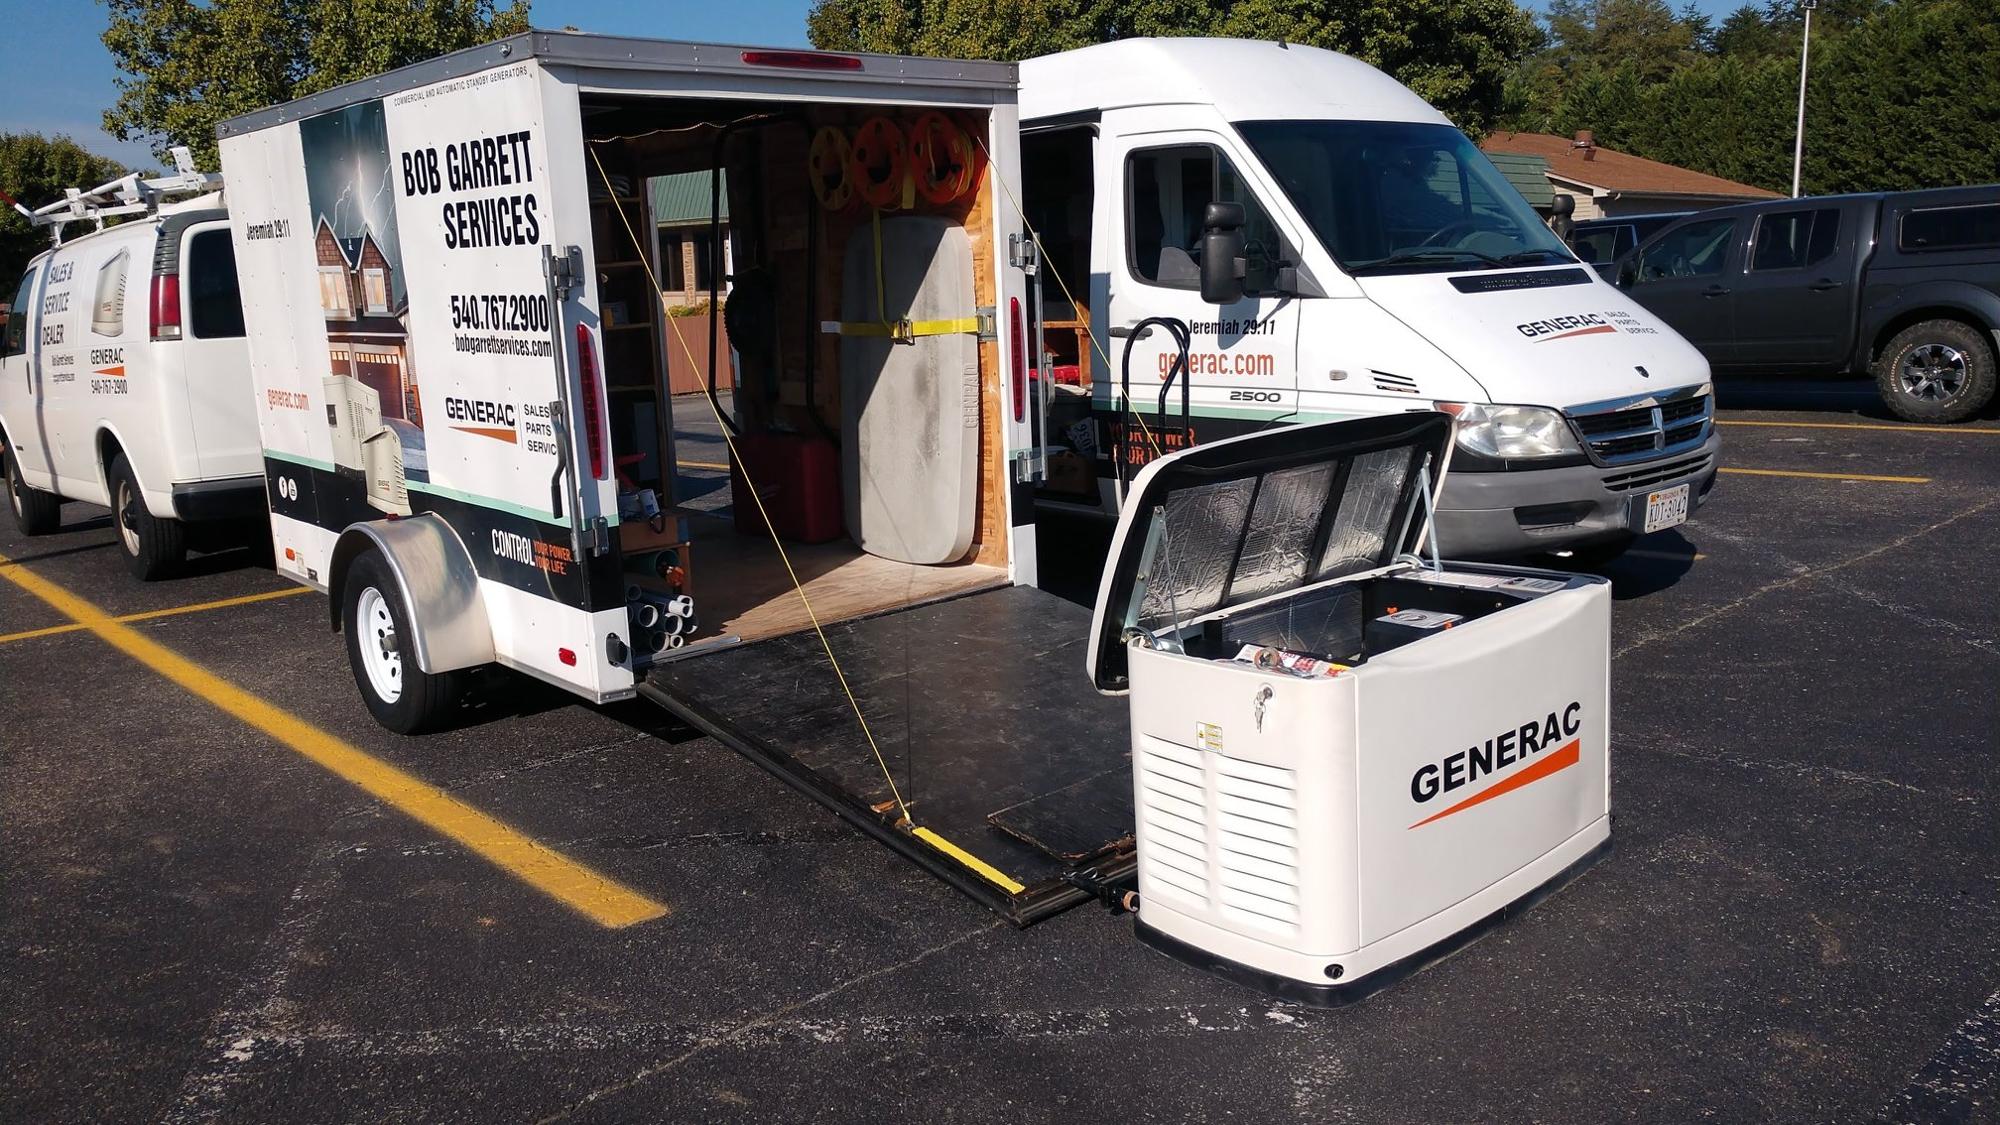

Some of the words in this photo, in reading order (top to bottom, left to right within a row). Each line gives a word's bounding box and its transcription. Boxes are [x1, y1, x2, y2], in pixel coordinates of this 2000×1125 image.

[394, 94, 425, 106] COMMERCIAL
[426, 88, 436, 98] AND
[436, 82, 465, 95] AUTOMATIC
[466, 75, 489, 89] STANDBY
[489, 65, 528, 83] GENERATORS
[402, 148, 441, 197] BOB
[445, 130, 533, 192] GARRETT
[246, 220, 274, 240] Jeremiah
[274, 219, 291, 238] 29:11
[443, 193, 540, 250] SERVICES
[48, 262, 67, 285] SALES
[67, 261, 74, 280] &
[43, 292, 70, 315] SERVICE
[450, 294, 550, 332] 540.767.2900
[42, 324, 64, 346] DEALER
[1189, 319, 1240, 335] Jeremiah
[1242, 319, 1275, 335] 29:11
[1517, 313, 1606, 338] GENERAC
[91, 348, 124, 365] GENERAC
[454, 333, 553, 358] bobgarrettservices.com
[1158, 352, 1274, 381] geerac.com
[91, 379, 128, 395] 540-767-2900
[1230, 391, 1281, 402] 2500
[267, 388, 310, 411] generac.com
[445, 397, 515, 427] GENERAC
[524, 403, 550, 418] SALES
[526, 421, 552, 437] PARTS
[527, 440, 557, 456] SERVIC
[491, 528, 535, 567] CONTROL
[533, 540, 549, 555] YOUR
[549, 544, 573, 562] POWER.
[534, 555, 550, 571] YOUR
[1411, 701, 1581, 803] GENERAC
